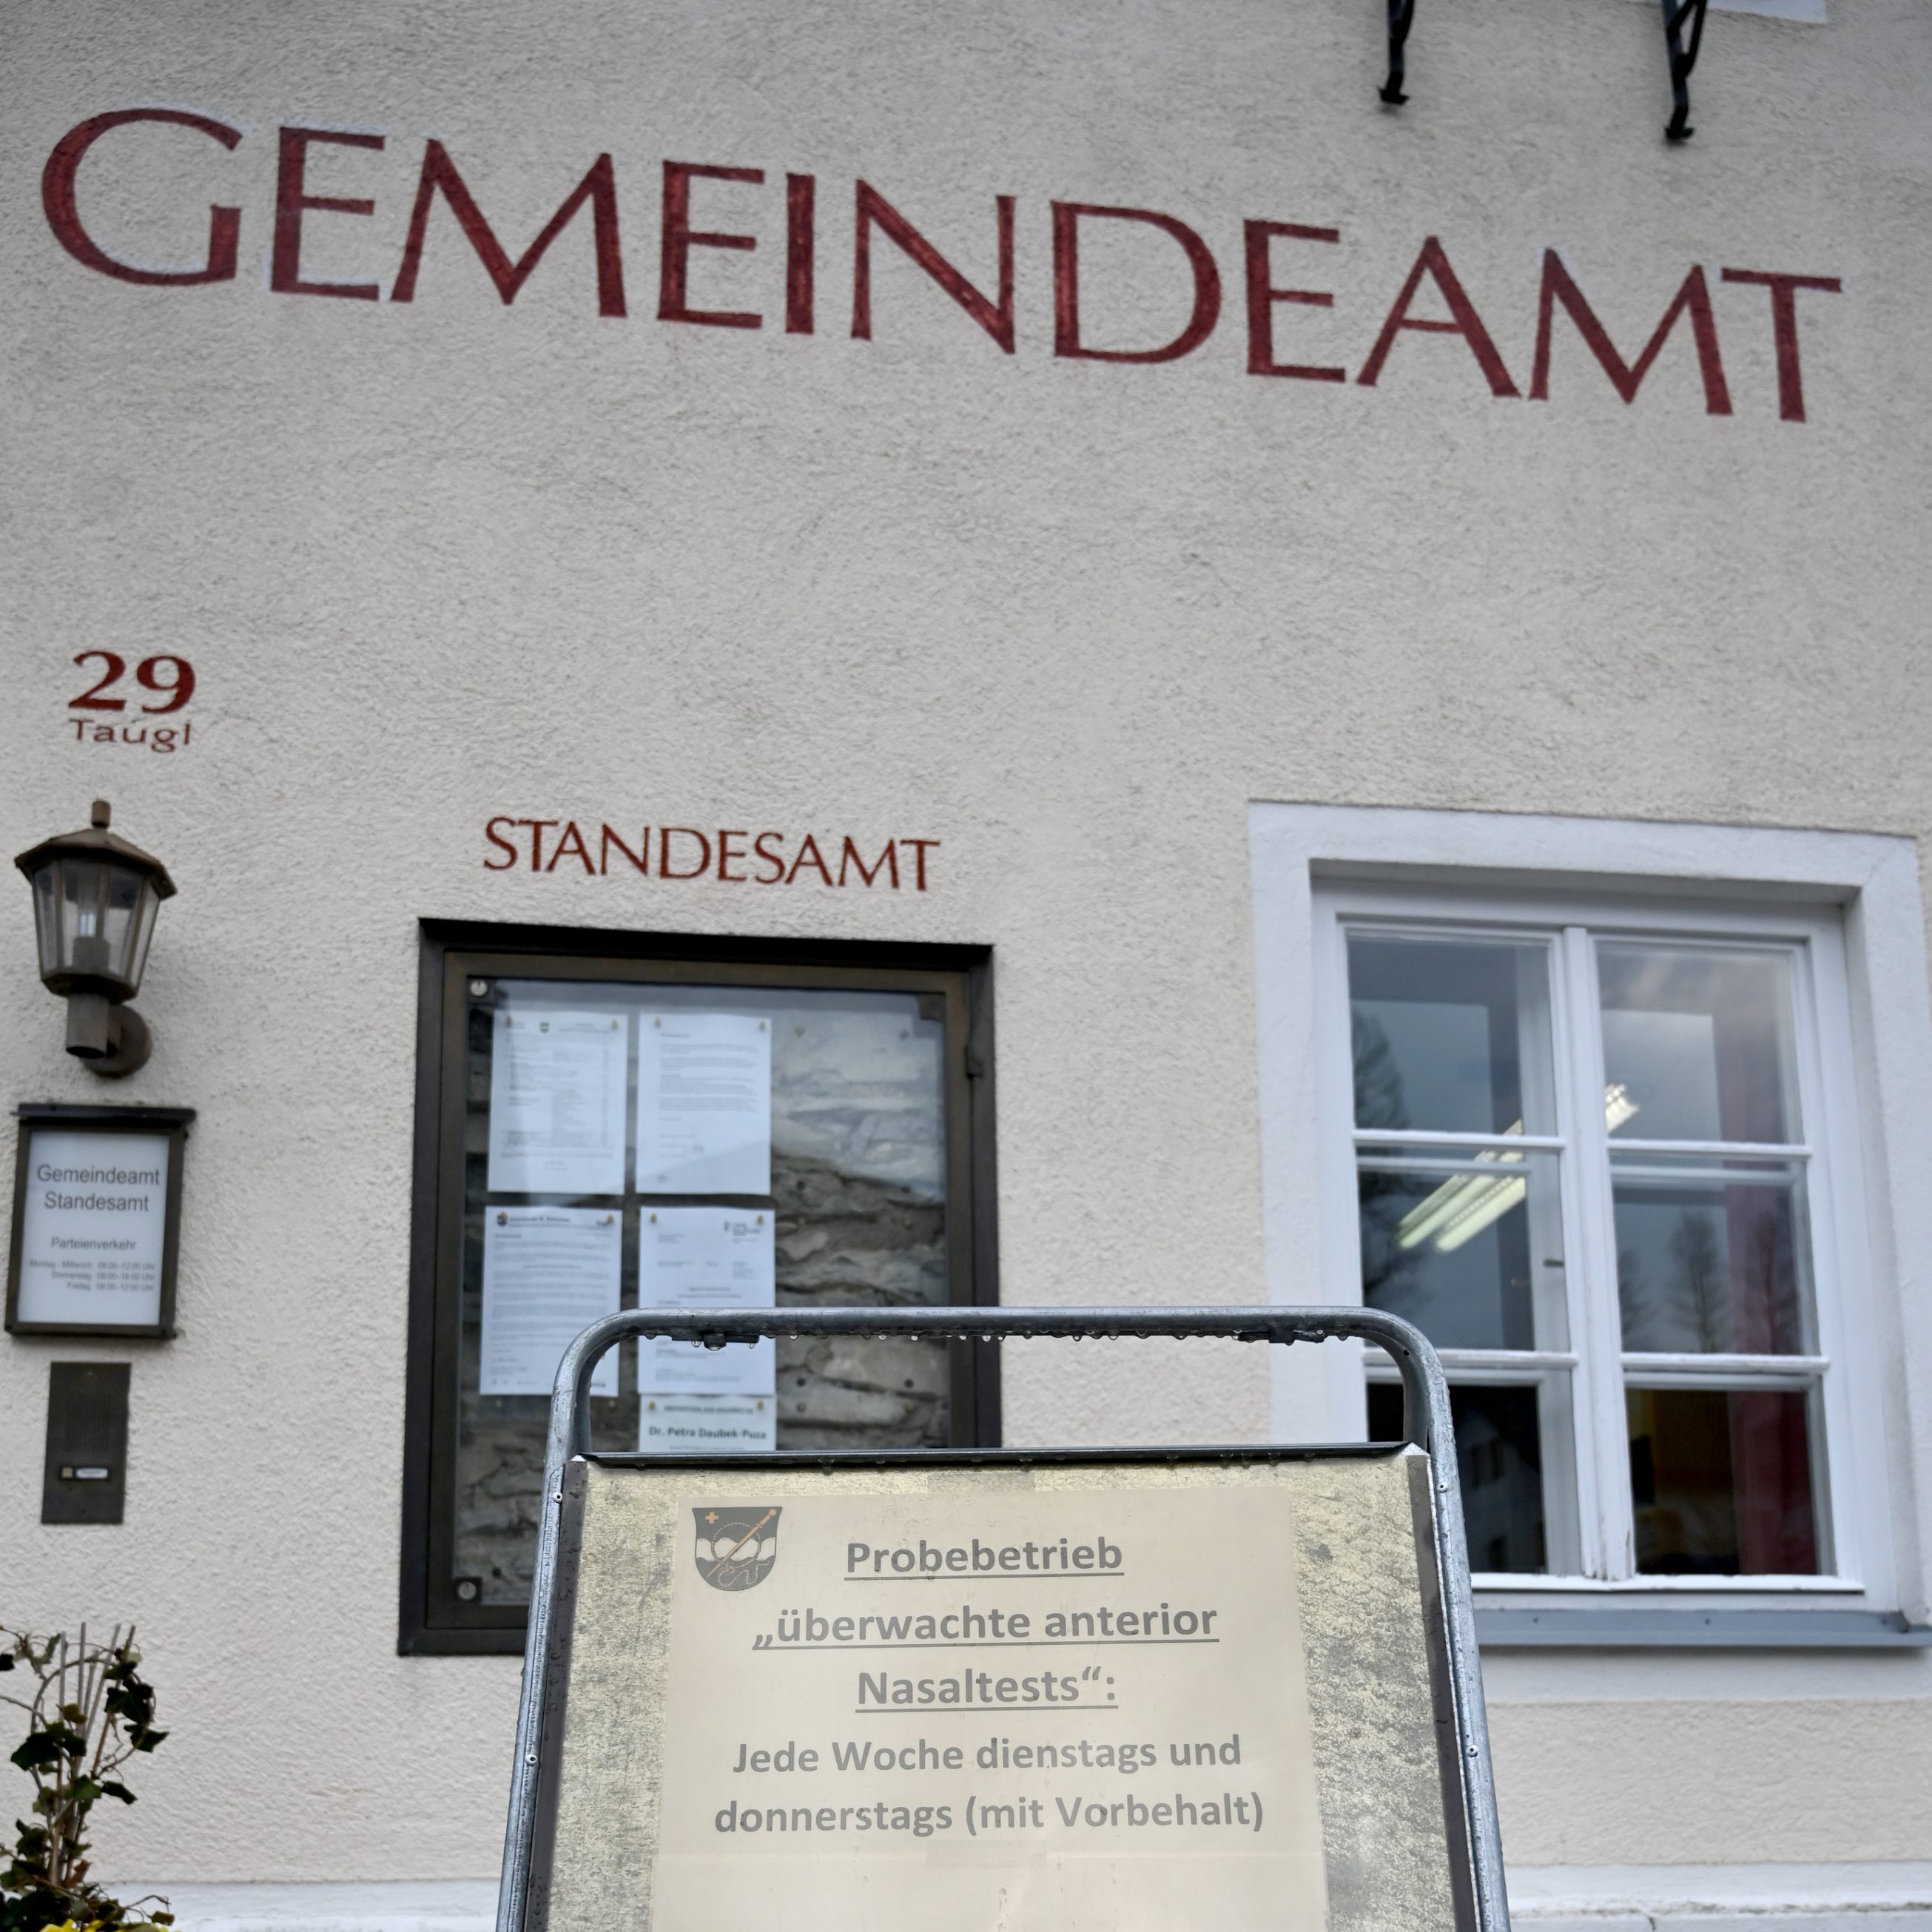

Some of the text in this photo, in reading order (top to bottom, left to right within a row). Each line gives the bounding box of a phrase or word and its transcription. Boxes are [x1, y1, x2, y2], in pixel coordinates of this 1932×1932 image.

[42, 109, 1841, 423] GEMEINDEAMT
[69, 650, 196, 714] 29
[68, 718, 191, 753] Taugl
[483, 815, 940, 891] STANDESAMT
[37, 1164, 161, 1185] Gemeindeamt
[44, 1191, 149, 1211] Standesamt
[51, 1236, 137, 1251] Parteienverkehr
[649, 1426, 665, 1437] Dr.
[668, 1427, 696, 1438] Petra
[846, 1535, 1123, 1573] Probebetrieb
[1044, 1602, 1219, 1638] anterior
[732, 1732, 1242, 1775] Jede Woche dienstags und
[714, 1791, 1264, 1838] donnerstags (mit Vorbehalt)
